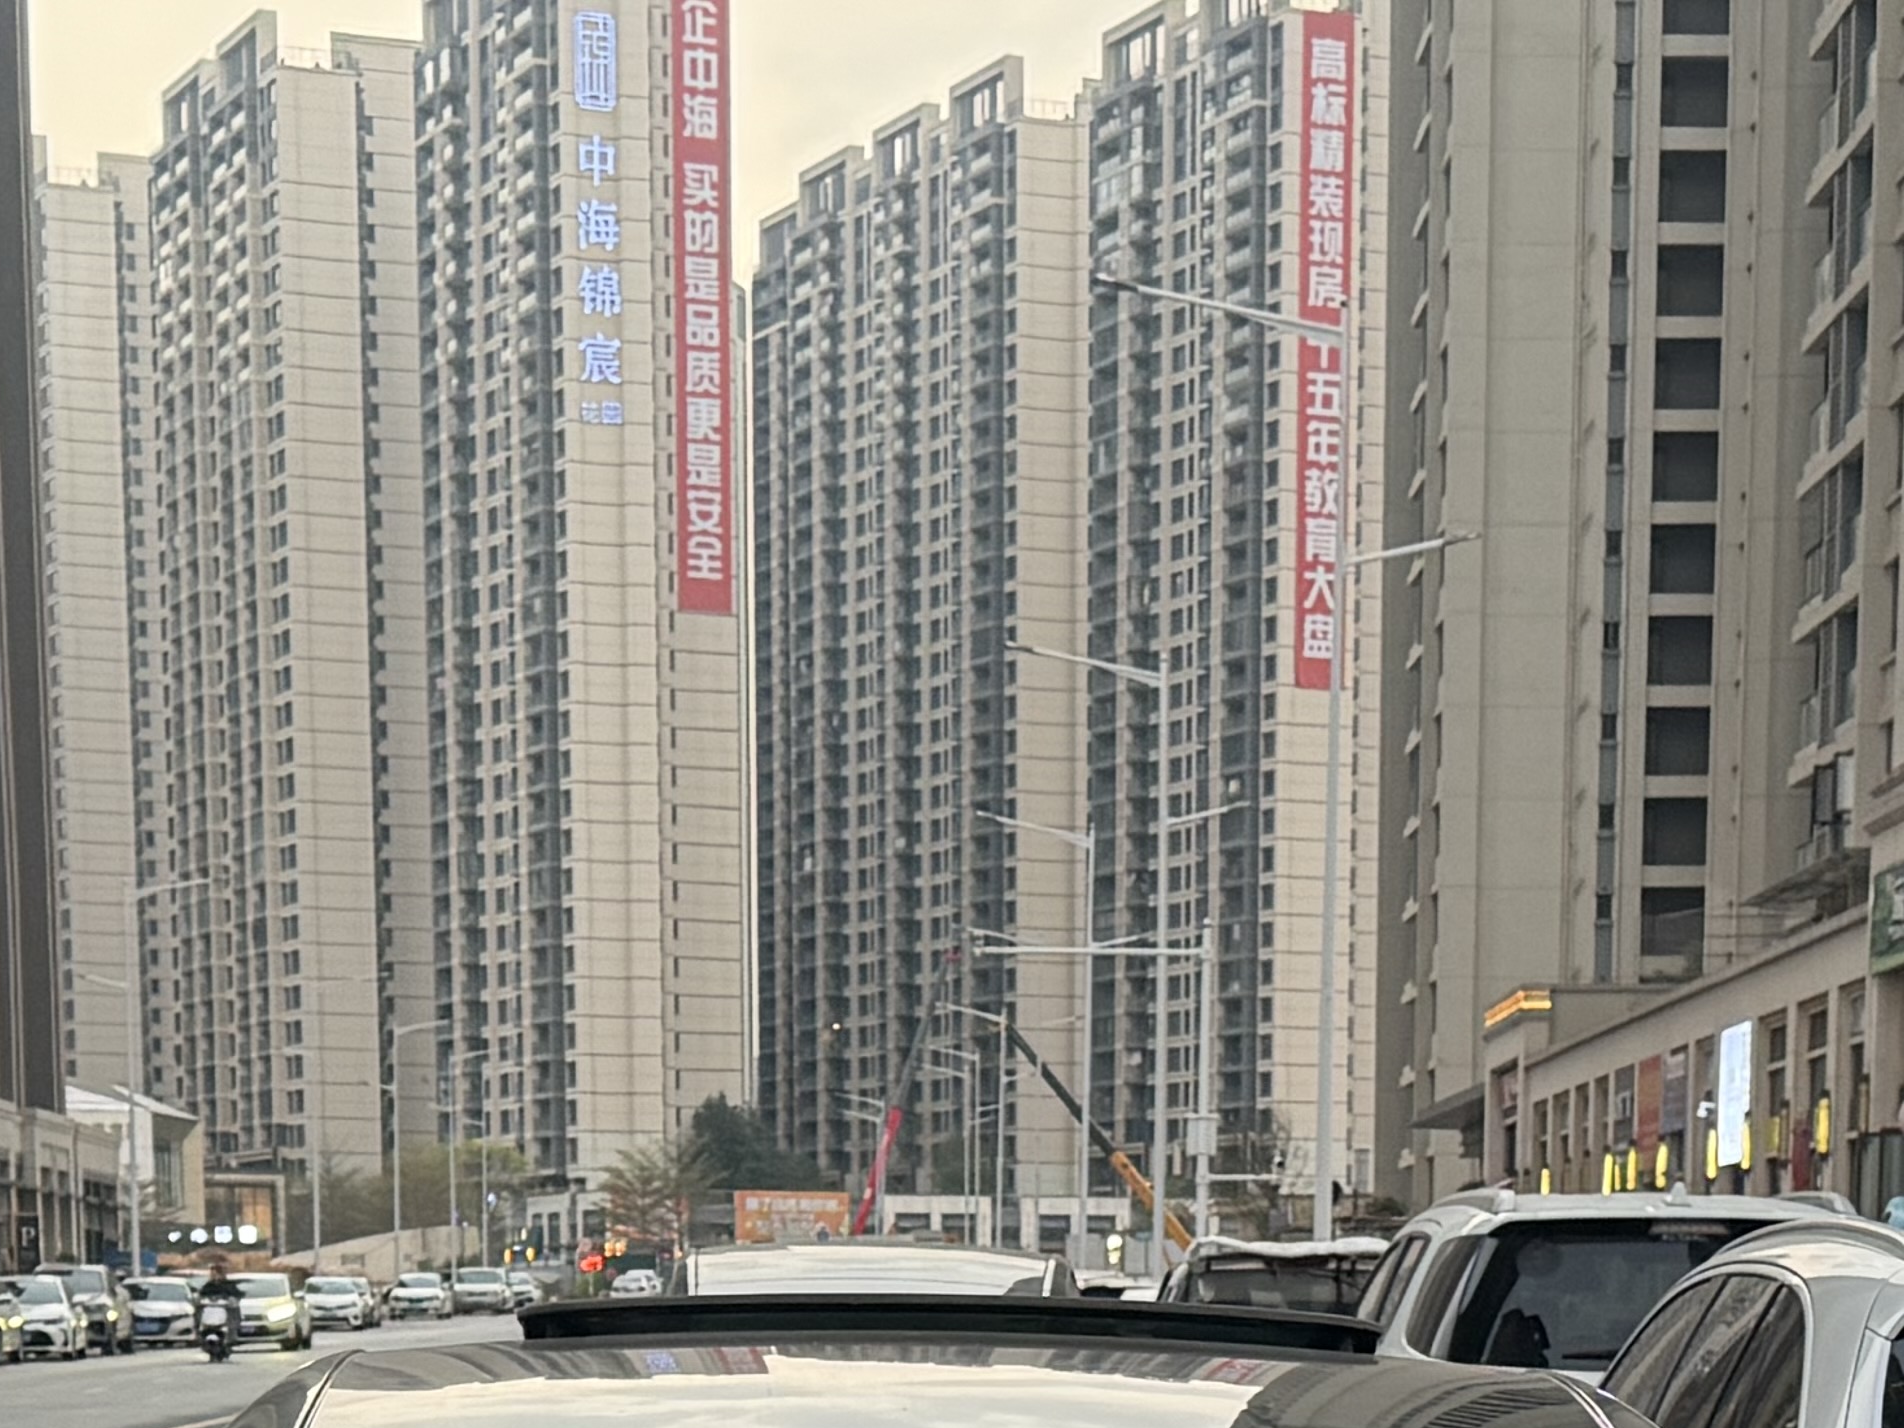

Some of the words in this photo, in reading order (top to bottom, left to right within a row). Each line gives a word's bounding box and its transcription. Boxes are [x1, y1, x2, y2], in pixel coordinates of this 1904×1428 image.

[577, 134, 623, 386] 中海锦宸
[1307, 38, 1346, 307] 高标精装现房
[682, 162, 724, 582] 买的是品质更是安全
